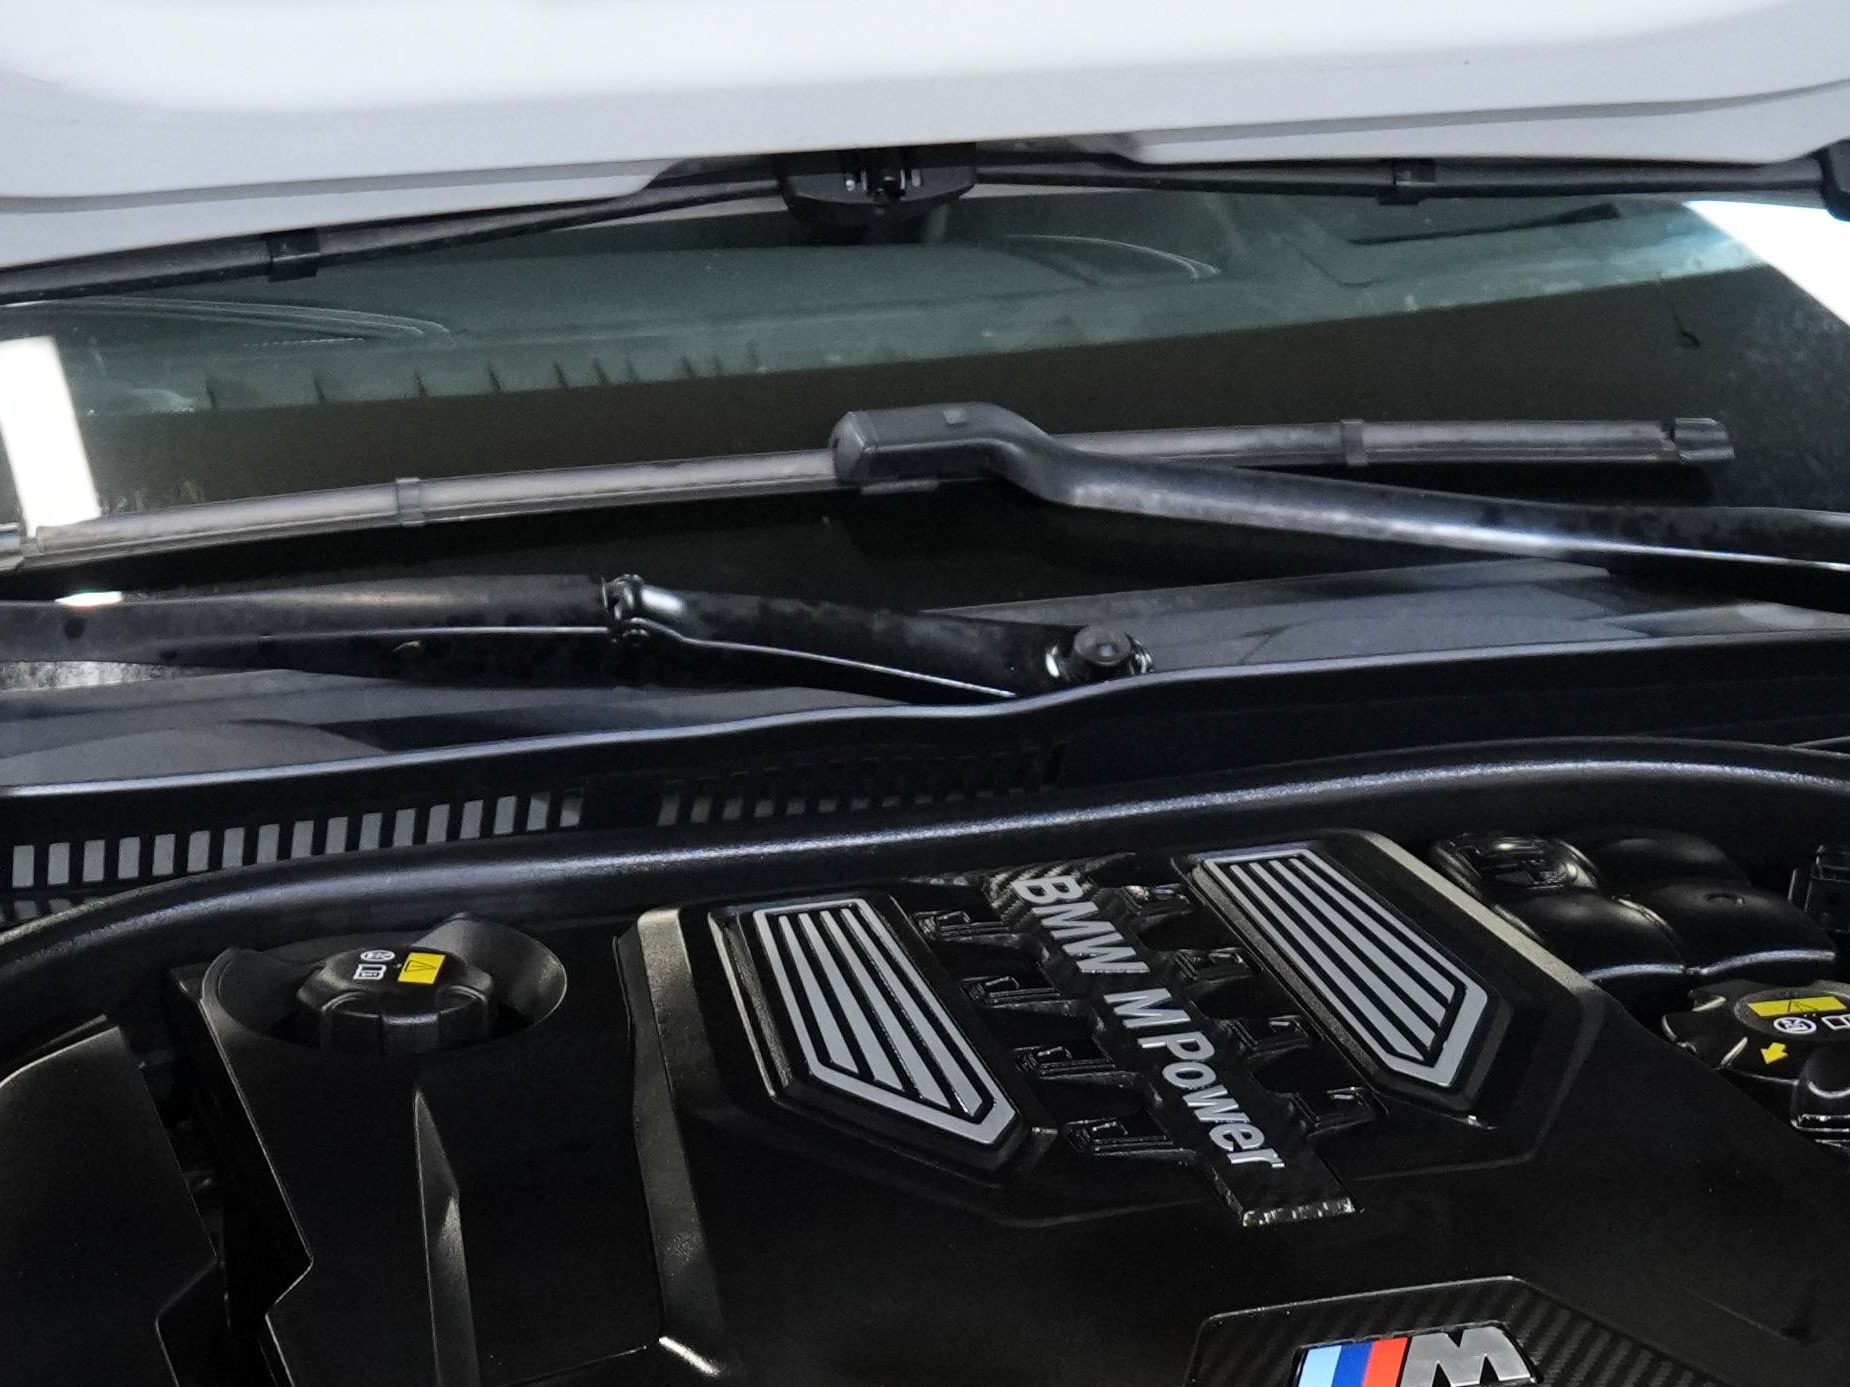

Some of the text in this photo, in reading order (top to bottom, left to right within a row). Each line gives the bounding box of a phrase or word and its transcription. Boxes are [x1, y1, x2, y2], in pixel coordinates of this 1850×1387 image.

[1011, 875, 1285, 1168] BMW M Power
